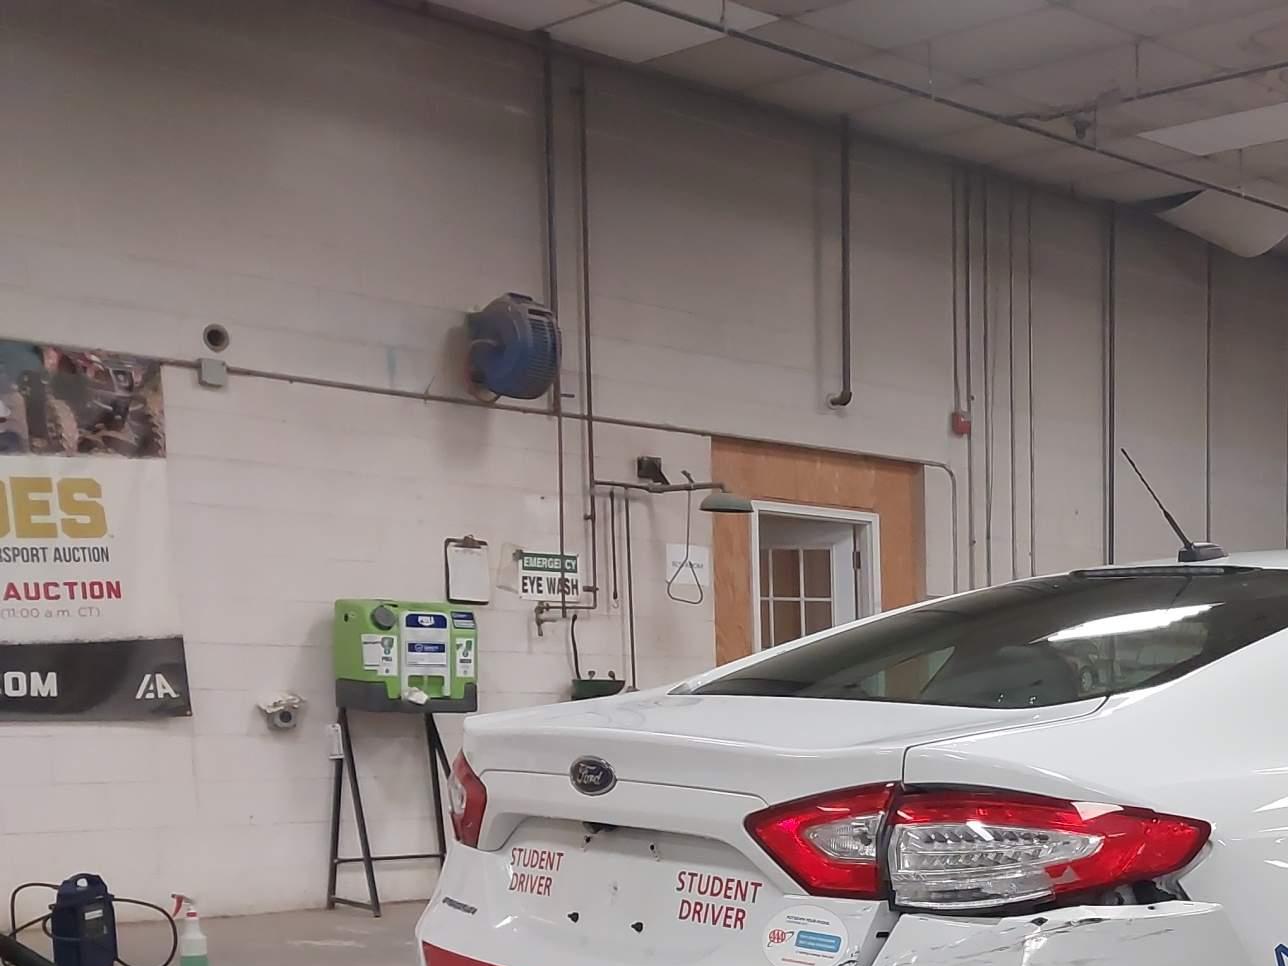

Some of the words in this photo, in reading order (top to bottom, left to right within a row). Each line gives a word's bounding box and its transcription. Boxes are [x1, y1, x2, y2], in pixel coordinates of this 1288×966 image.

[0, 476, 108, 538] ES
[0, 547, 48, 563] SPORT
[53, 546, 110, 563] AUCTION
[523, 556, 577, 570] EMERGECY
[4, 581, 122, 601] AUCTION
[522, 576, 544, 594] EYE
[0, 671, 58, 698] OM
[510, 847, 564, 872] STUDENT
[509, 872, 552, 896] DRIVER
[676, 870, 763, 903] STUDENT
[678, 899, 747, 930] DRIVER
